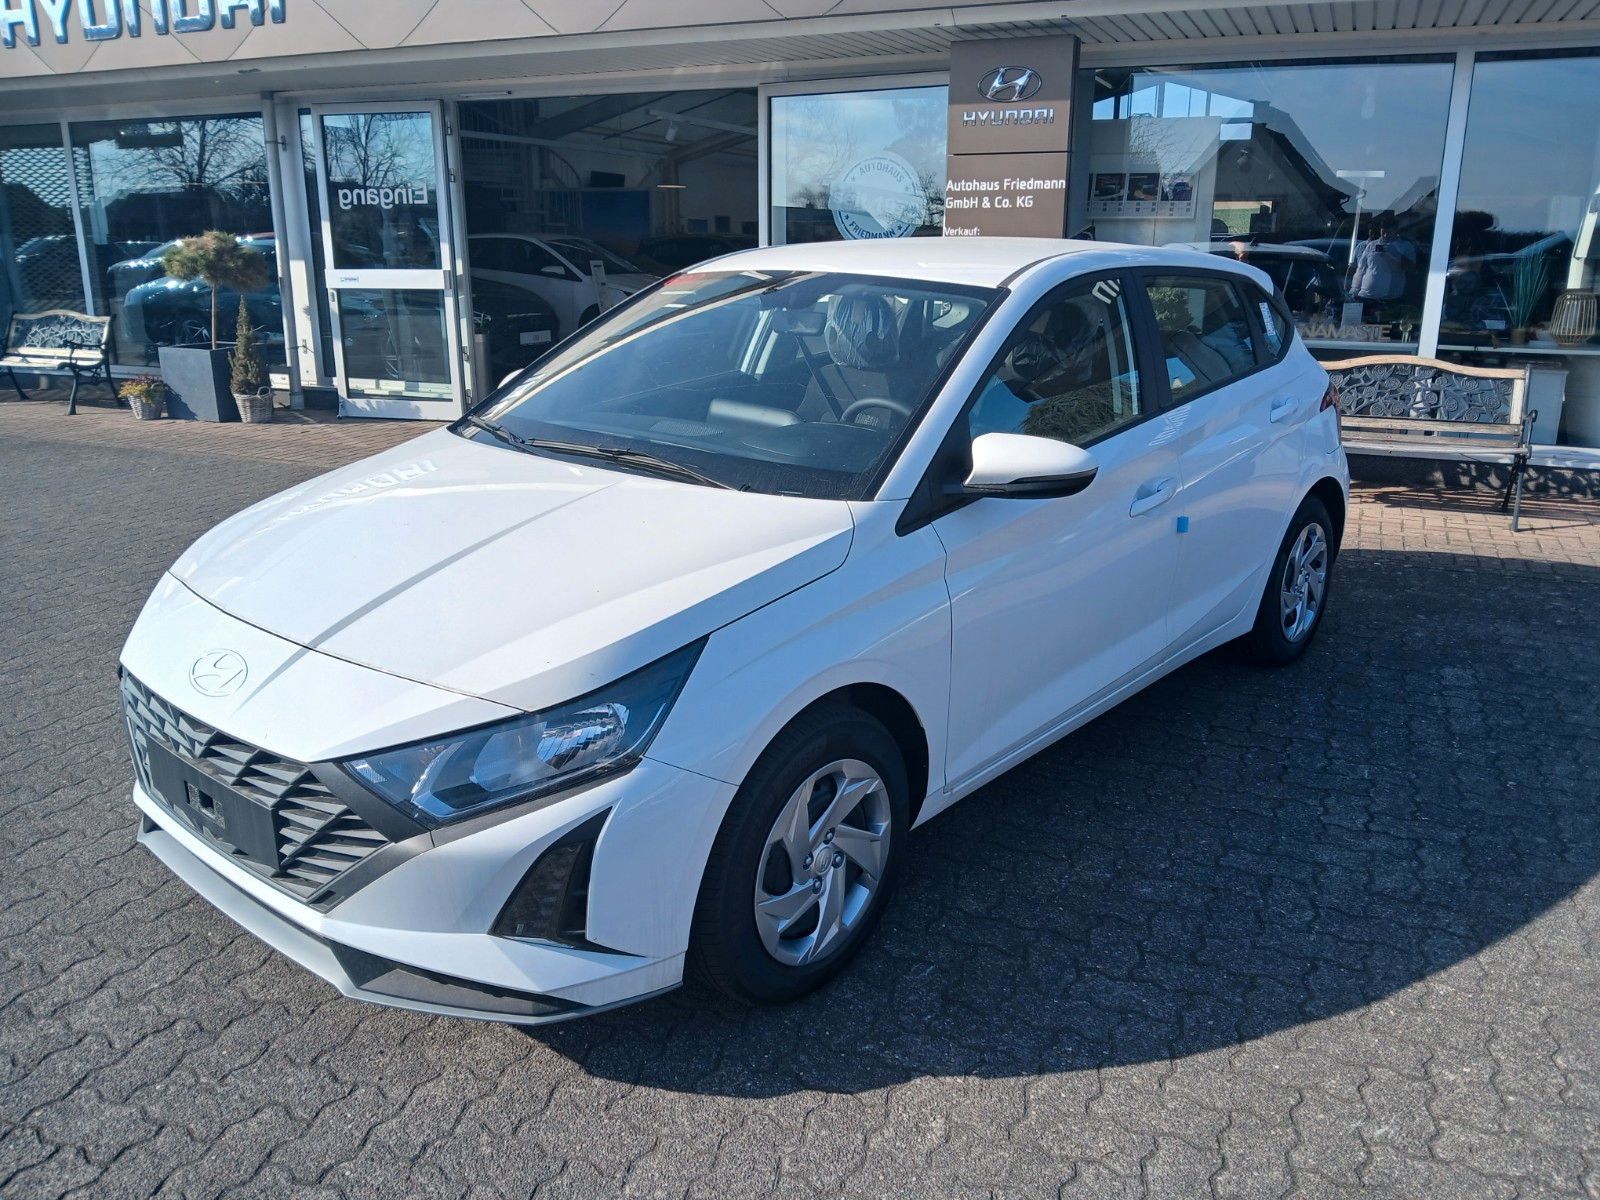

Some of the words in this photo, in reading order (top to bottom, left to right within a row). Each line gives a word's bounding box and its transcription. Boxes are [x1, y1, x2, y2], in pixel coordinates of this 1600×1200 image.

[963, 108, 1055, 127] HYUNDAI
[859, 161, 905, 184] AUTOHAUS
[945, 178, 1000, 192] Autohaus
[1003, 177, 1066, 191] Friedmann
[945, 197, 978, 209] GmbH
[982, 197, 991, 209] &
[994, 197, 1013, 209] Co.
[1016, 195, 1034, 208] KG
[848, 220, 896, 240] FRIEDMANN
[943, 226, 981, 236] Verkauf:
[1300, 323, 1393, 341] NAMASTE
